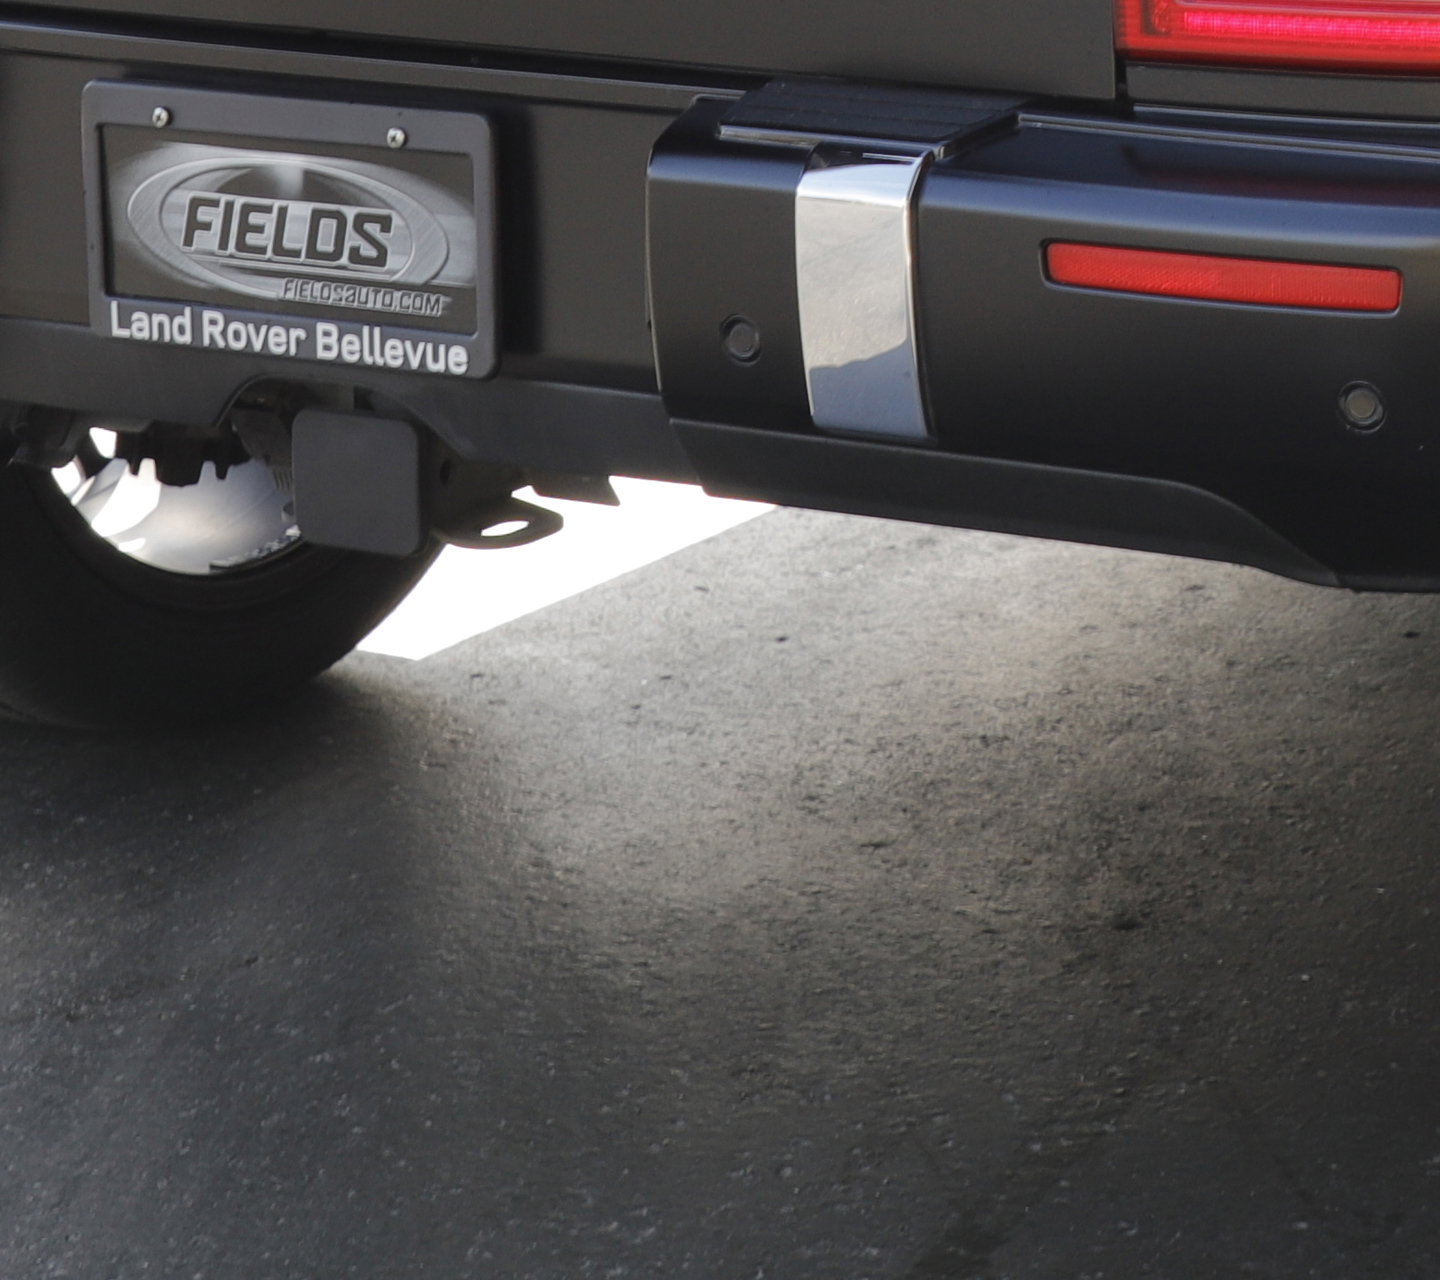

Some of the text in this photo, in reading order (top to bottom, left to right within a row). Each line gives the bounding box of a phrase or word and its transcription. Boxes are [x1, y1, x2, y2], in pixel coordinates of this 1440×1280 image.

[181, 196, 392, 269] FIELDS
[111, 301, 468, 375] Land Rover Bellevue
